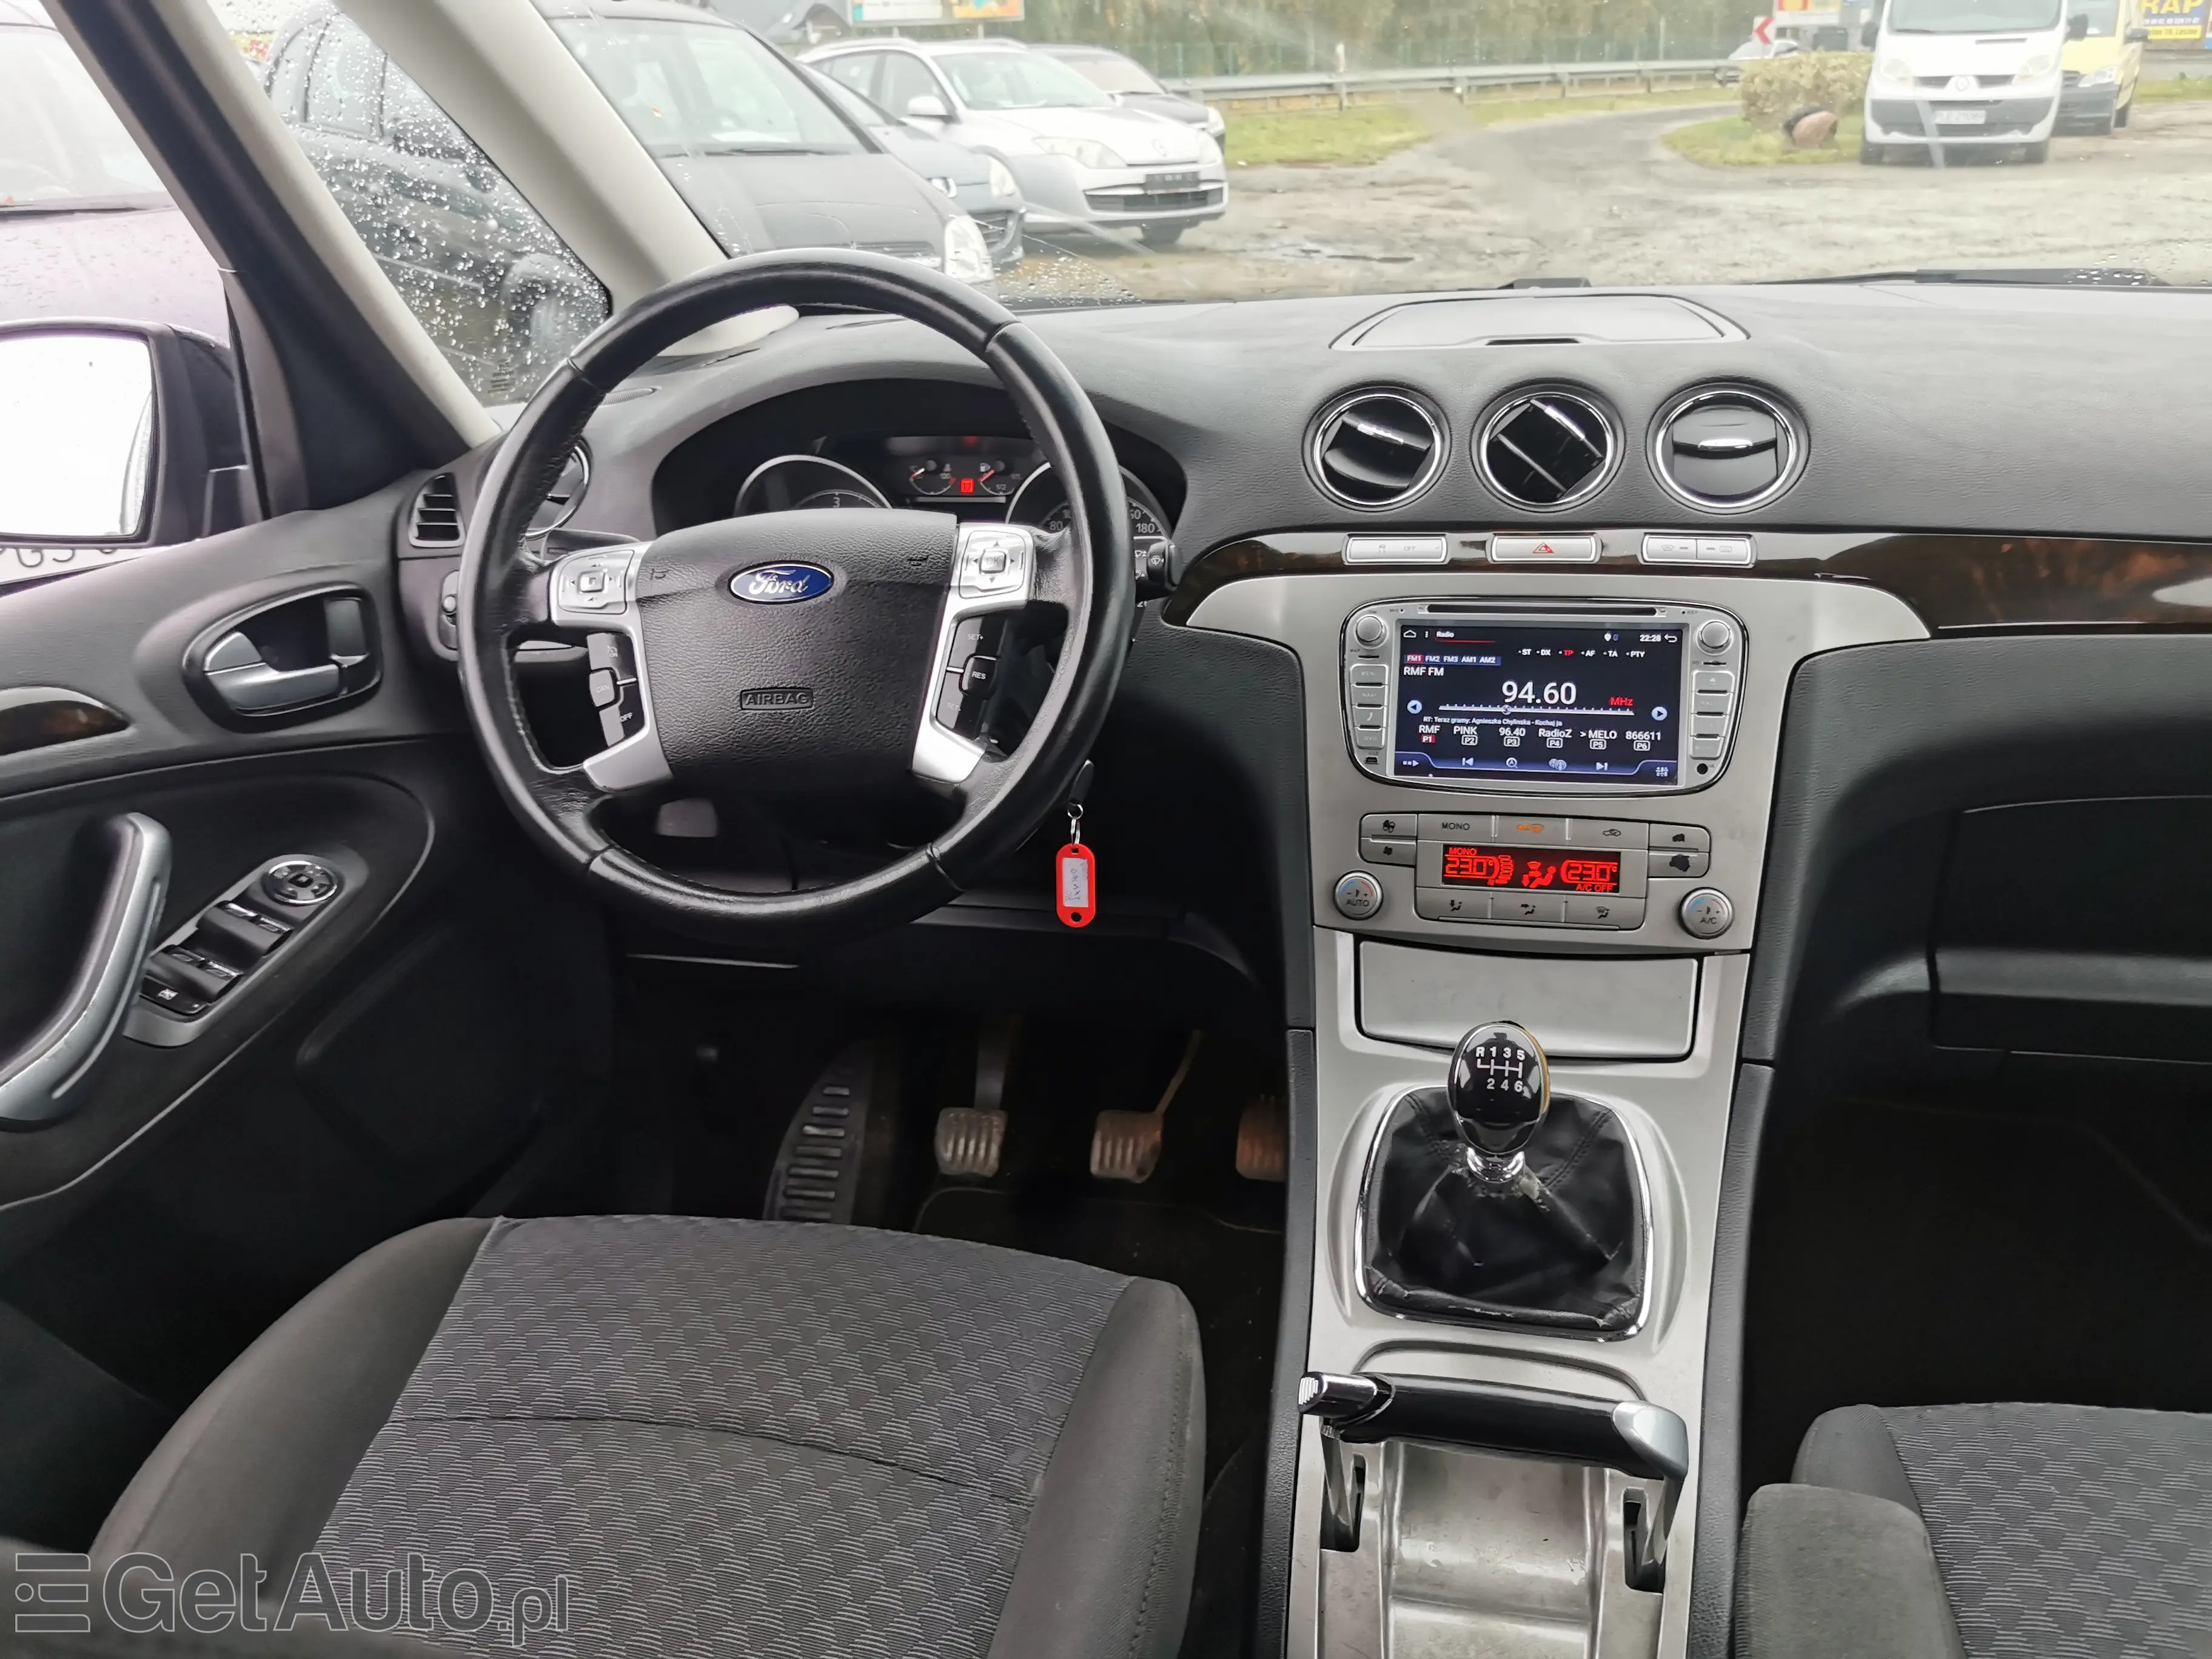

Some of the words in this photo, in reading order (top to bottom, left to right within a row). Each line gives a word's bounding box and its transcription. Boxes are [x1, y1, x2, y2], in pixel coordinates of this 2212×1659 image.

[833, 497, 841, 508] 3
[1136, 523, 1155, 533] 180
[985, 555, 1000, 565] OK
[749, 569, 808, 595] Ford
[971, 671, 987, 680] RES
[1403, 666, 1426, 676] RMF
[1428, 667, 1444, 677] FM
[1502, 680, 1577, 705] 94.60
[745, 692, 808, 705] AIRBAG
[1609, 697, 1634, 707] MHz
[620, 712, 634, 722] OFF
[1418, 725, 1441, 734] RMF
[1453, 726, 1478, 735] PINK
[1498, 727, 1526, 737] 96.40
[1538, 728, 1572, 738] RadioZ
[1588, 730, 1618, 739] MELO
[1625, 731, 1661, 741] 866611
[1441, 822, 1470, 831] MONO
[1449, 846, 1478, 856] MONO
[1346, 899, 1370, 907] AUTO
[1699, 916, 1717, 925] A/C
[1475, 1047, 1485, 1057] R
[1489, 1046, 1496, 1057] 1
[1503, 1047, 1512, 1058] 3
[1517, 1049, 1526, 1061] 5
[1486, 1078, 1495, 1090] 2
[1500, 1079, 1509, 1091] 4
[1514, 1080, 1524, 1093] 6
